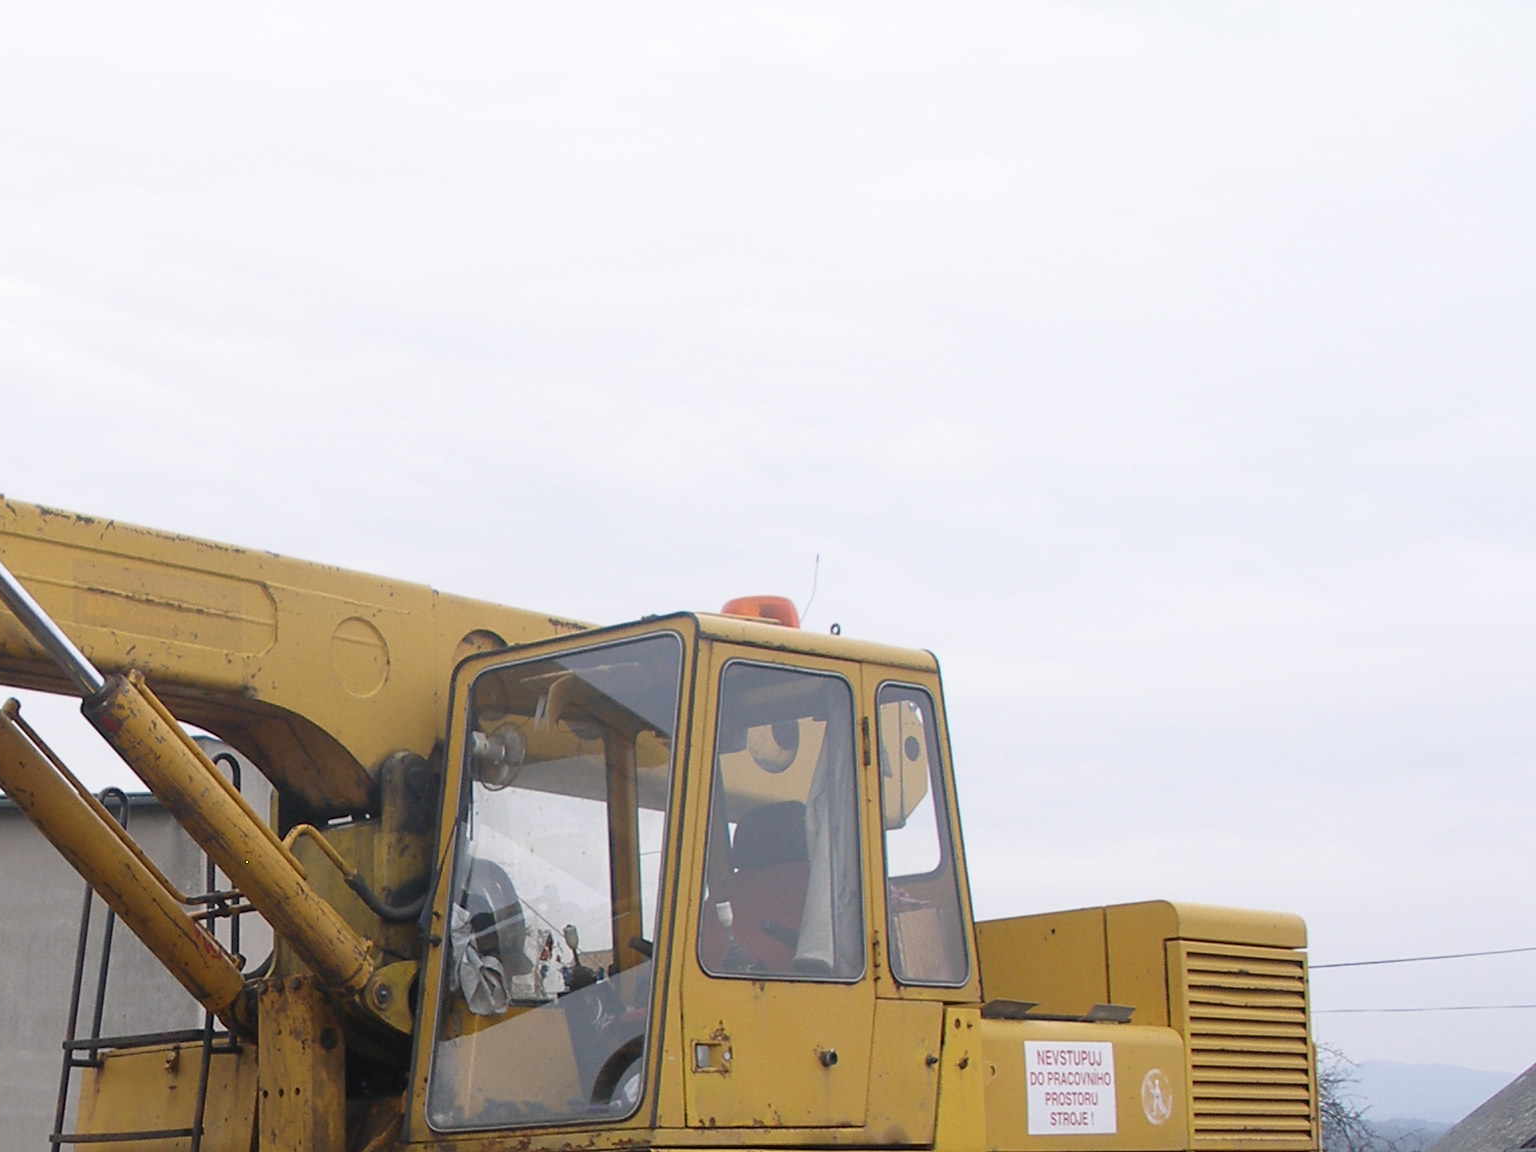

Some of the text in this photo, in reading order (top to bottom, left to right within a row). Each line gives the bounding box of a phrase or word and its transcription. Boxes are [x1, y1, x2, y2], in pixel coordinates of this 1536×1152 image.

[1036, 1049, 1103, 1067] NEVSTUPUJ
[1030, 1068, 1112, 1086] DO PRACOVNÍHO
[1045, 1091, 1099, 1107] PROSTORU
[1049, 1111, 1089, 1127] STROJE
